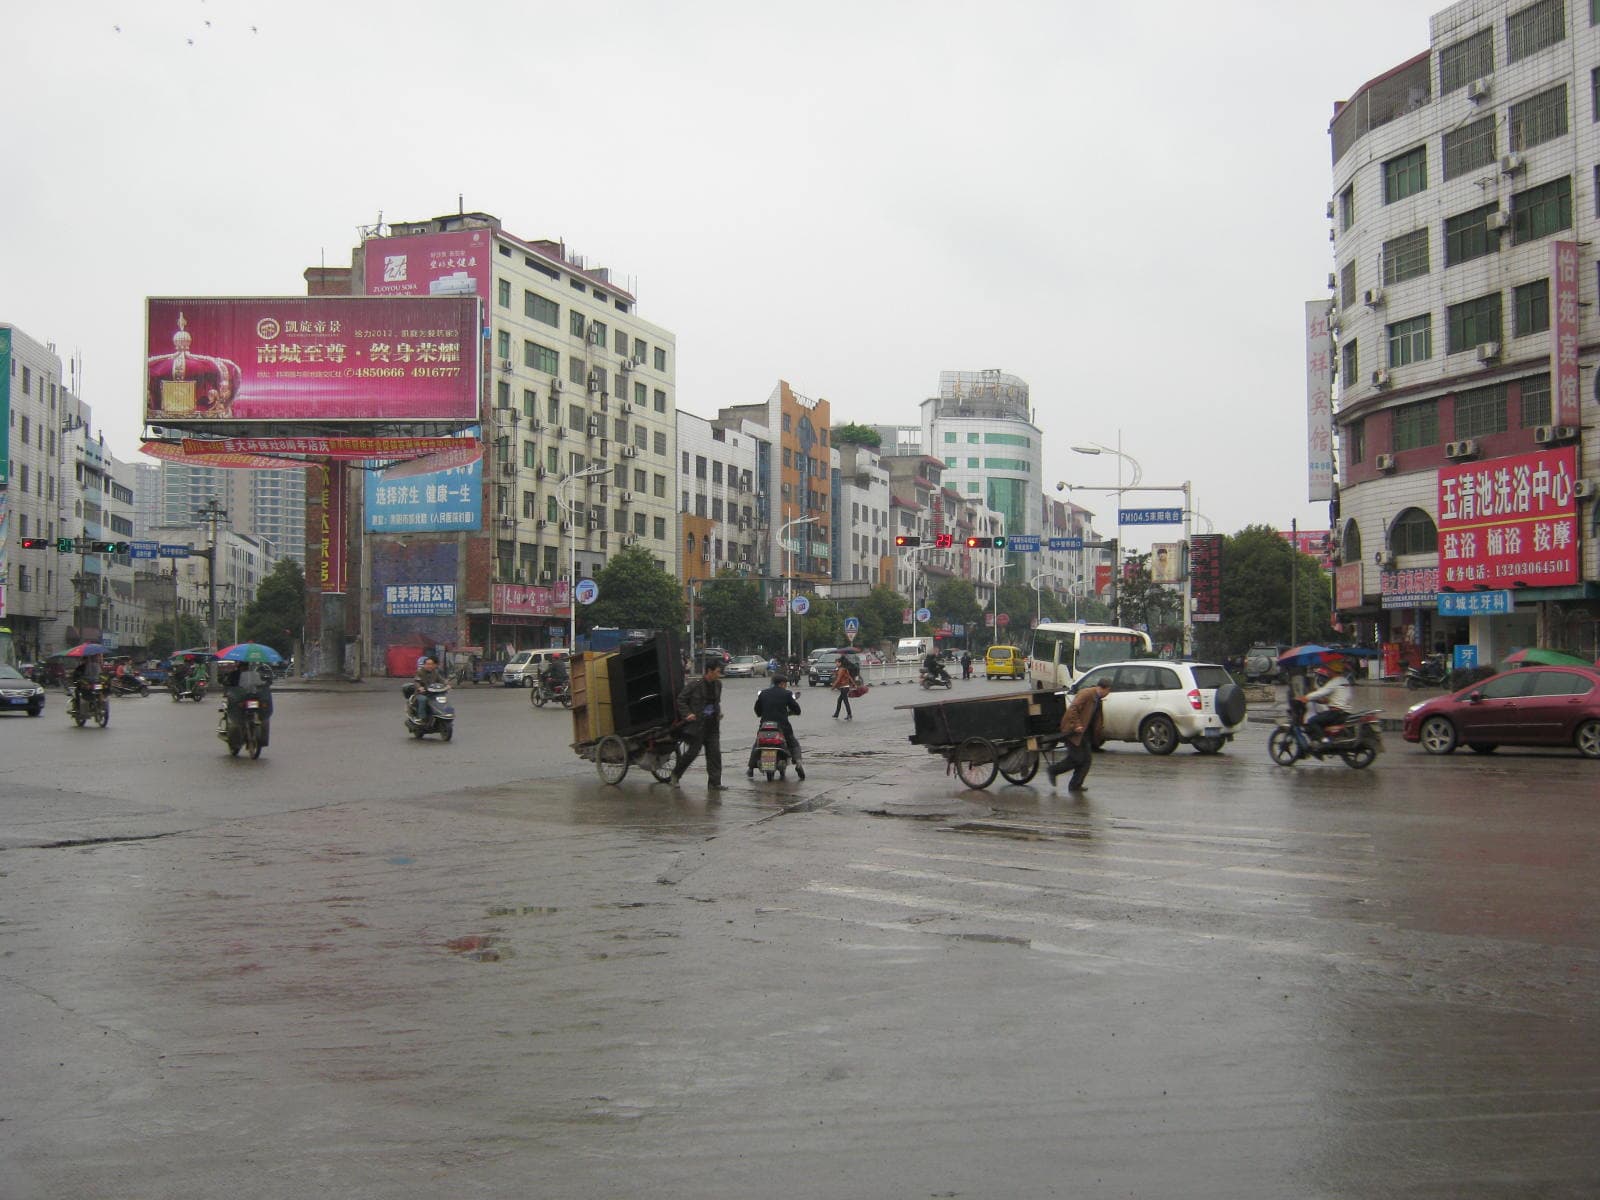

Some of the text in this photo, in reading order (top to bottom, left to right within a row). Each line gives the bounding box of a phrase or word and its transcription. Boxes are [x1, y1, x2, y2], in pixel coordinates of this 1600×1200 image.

[355, 367, 461, 377] 4850666 4916777
[1309, 316, 1330, 450] 红祥宾馆
[376, 483, 471, 505] 选择济生 健康一生
[1441, 461, 1571, 520] 玉清池洗浴中心
[1443, 520, 1570, 560] 盐浴 桶浴 按摩
[1456, 594, 1504, 610] 城北牙科
